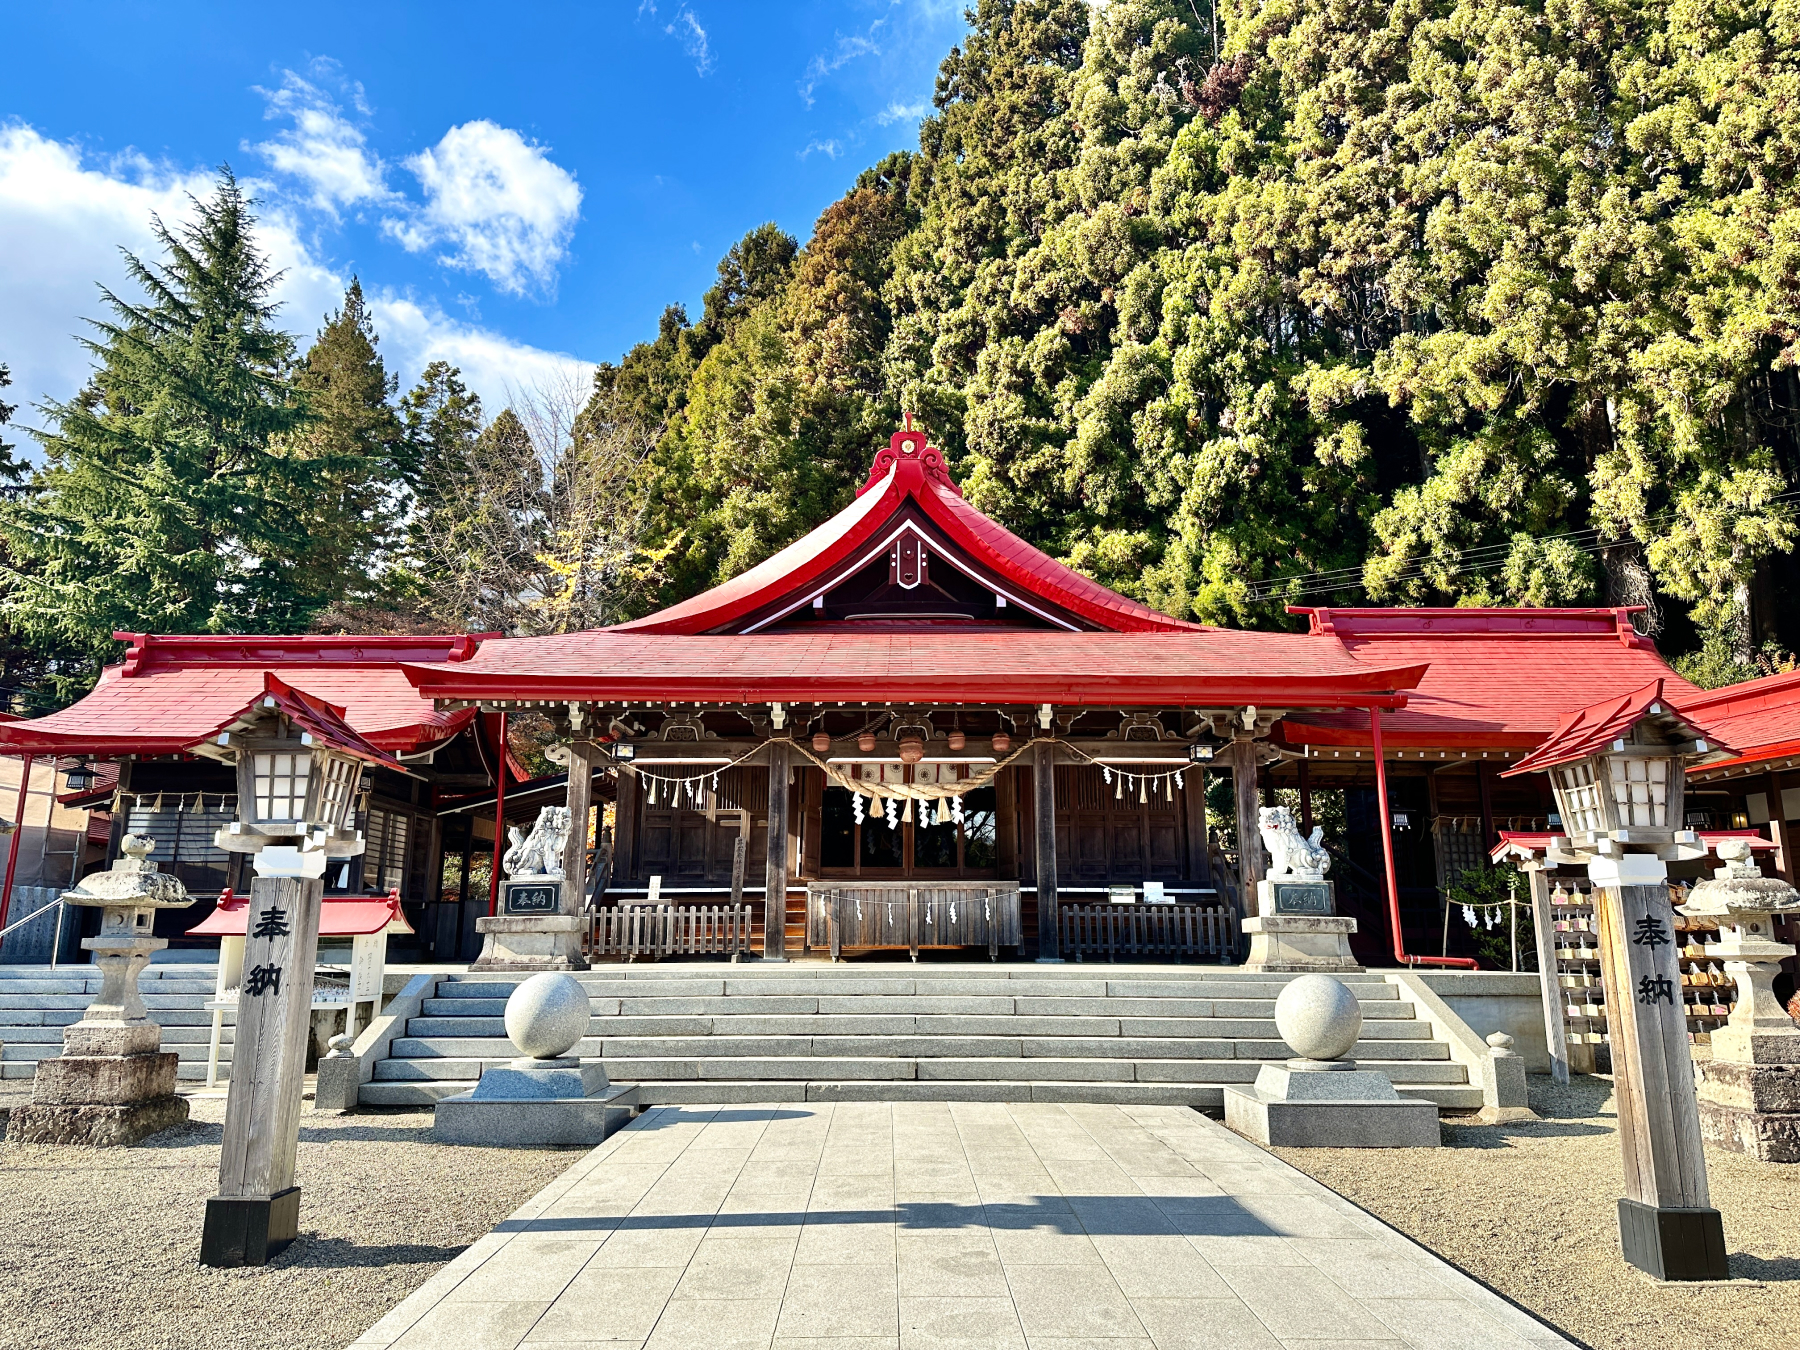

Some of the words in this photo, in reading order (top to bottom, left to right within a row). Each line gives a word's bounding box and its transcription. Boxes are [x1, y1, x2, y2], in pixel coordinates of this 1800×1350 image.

[515, 890, 546, 906] 奉納
[1287, 890, 1317, 906] 奉納
[244, 905, 291, 997] 奉納
[1632, 913, 1674, 1006] 奉納
